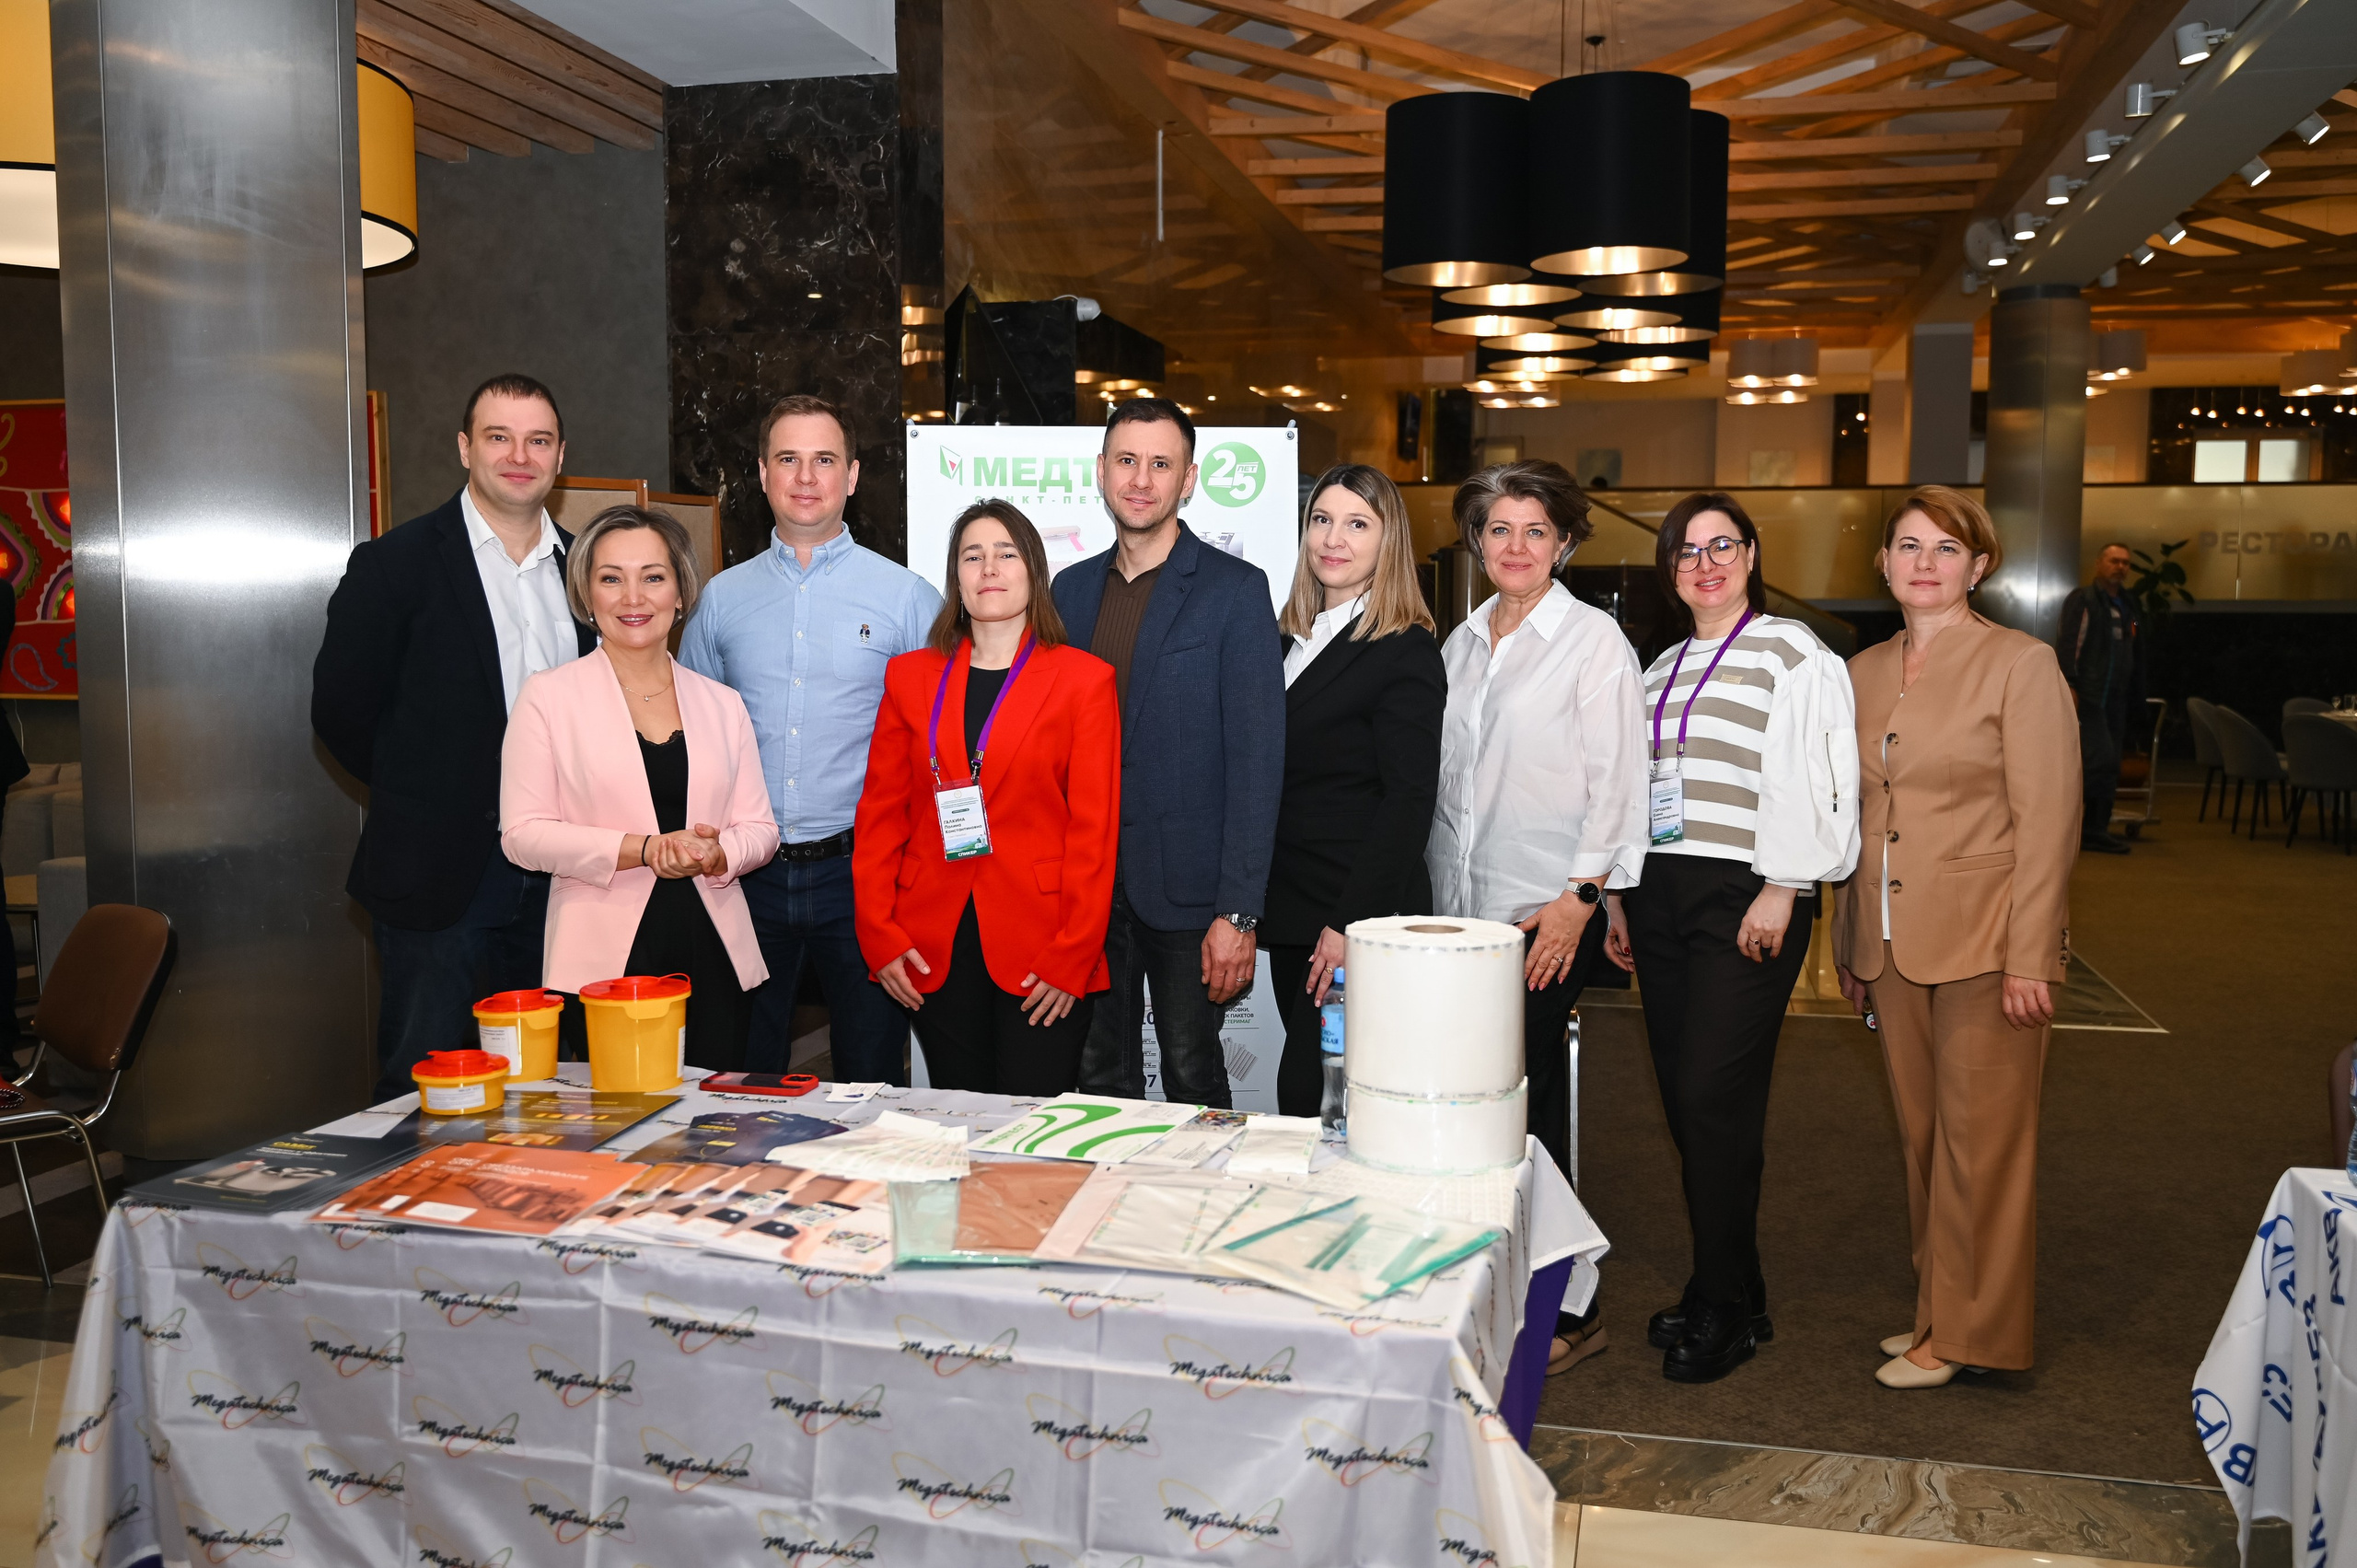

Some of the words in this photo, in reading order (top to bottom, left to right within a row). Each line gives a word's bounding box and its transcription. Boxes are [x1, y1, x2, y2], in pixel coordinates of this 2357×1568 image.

[974, 457, 1097, 493] МЕДТ
[2199, 531, 2357, 553] РЕСТОРА
[958, 849, 977, 857] СПИКЕР
